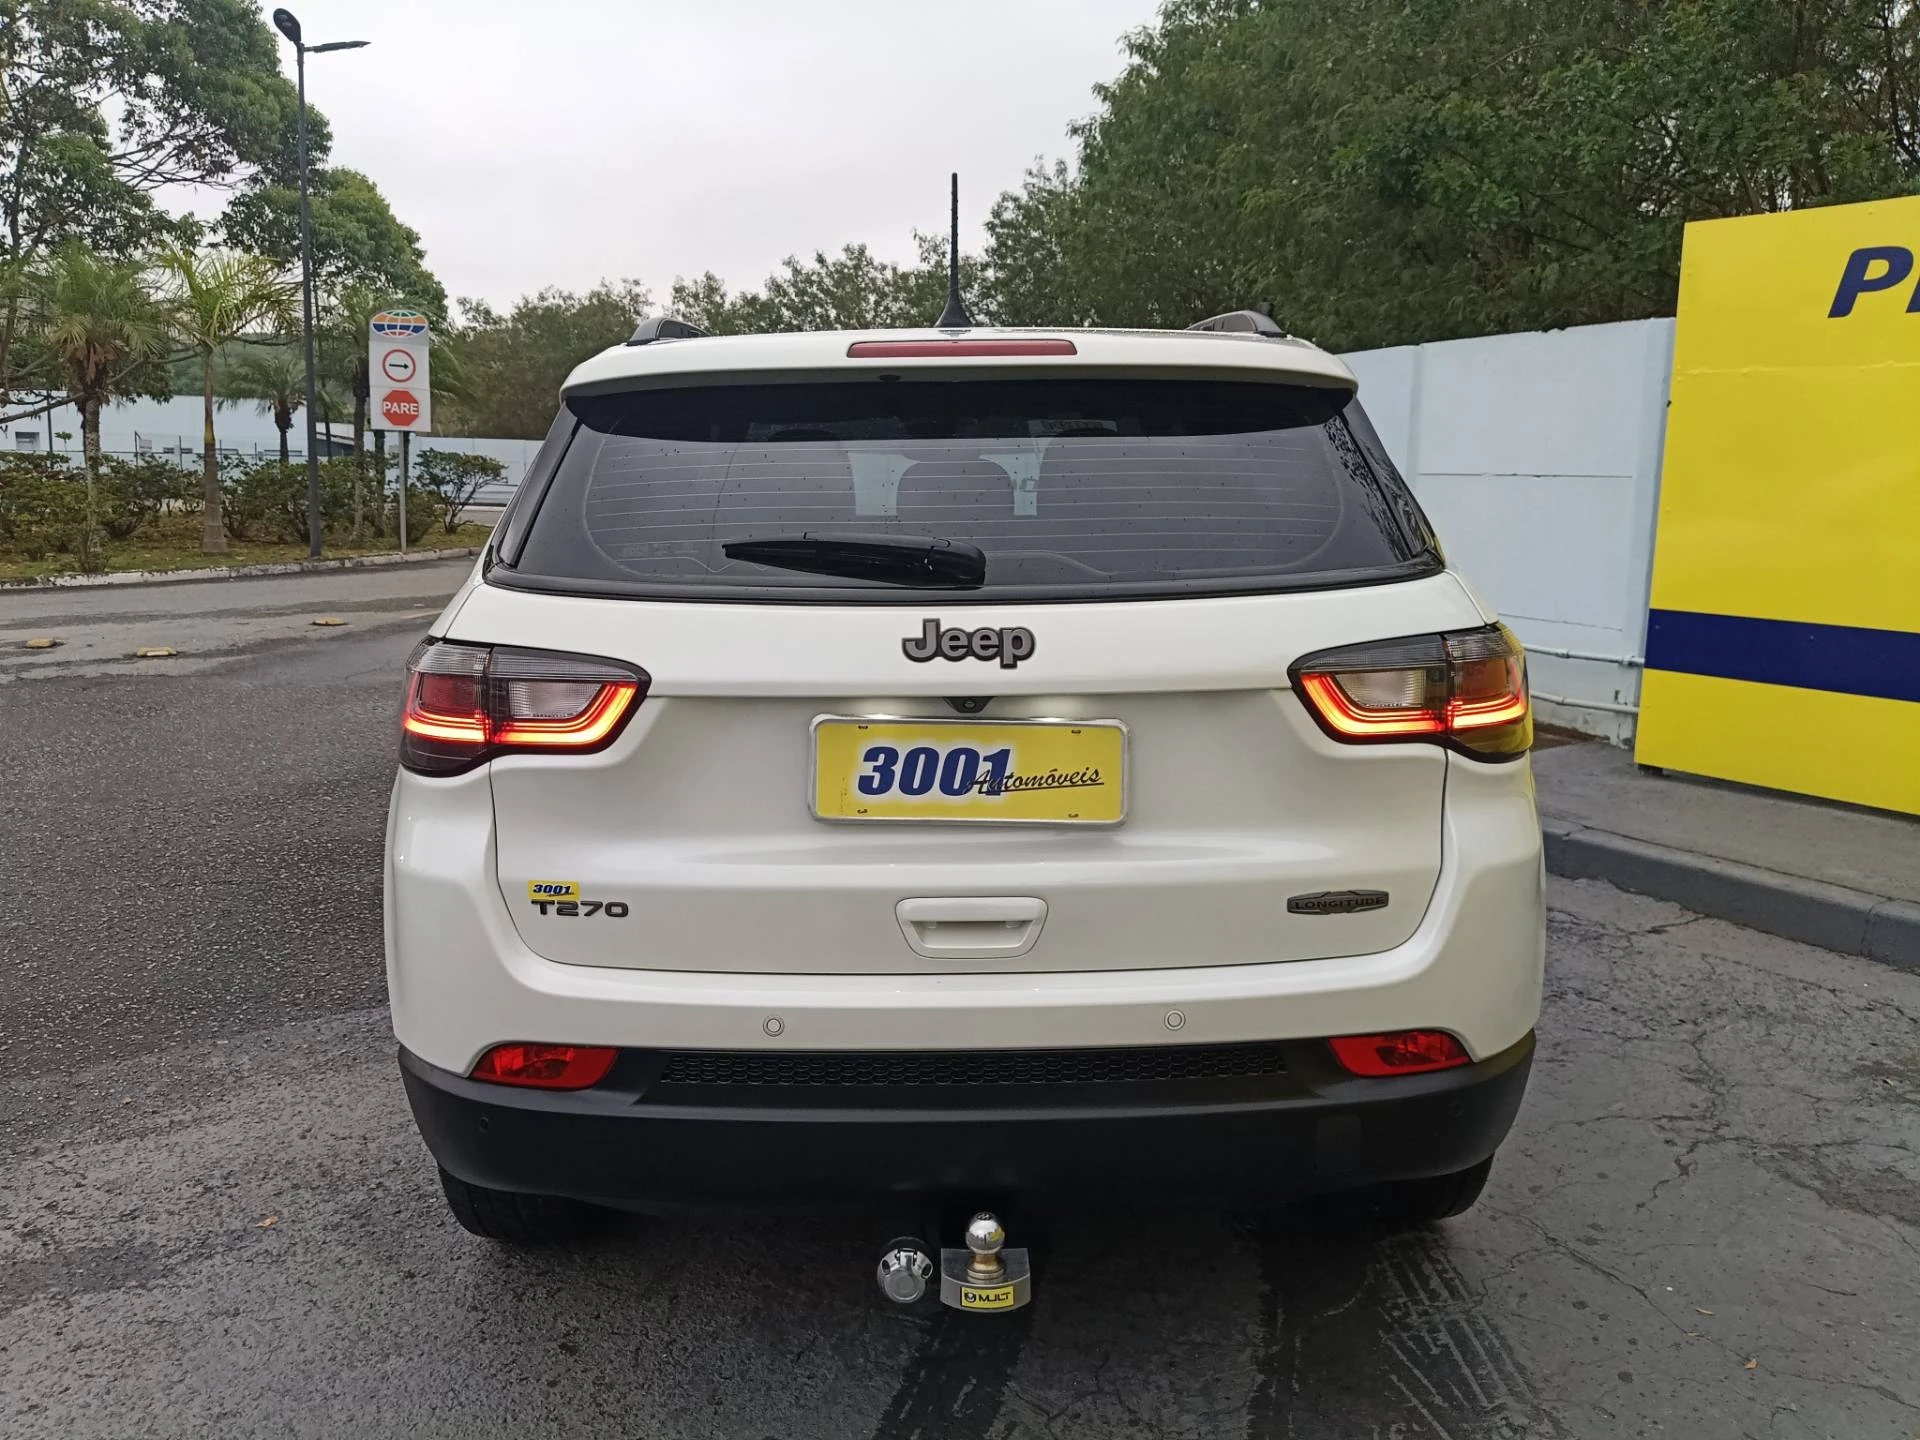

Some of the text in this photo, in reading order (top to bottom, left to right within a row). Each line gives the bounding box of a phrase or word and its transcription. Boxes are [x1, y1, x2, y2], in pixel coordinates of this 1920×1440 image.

[1827, 245, 1920, 318] P
[383, 401, 418, 415] PARE
[902, 618, 1036, 669] Jeep
[857, 746, 1011, 796] 3001
[966, 766, 1102, 795] Automóveis
[533, 884, 571, 894] 3001
[530, 899, 629, 917] T270
[1295, 896, 1386, 909] LONGITUDE
